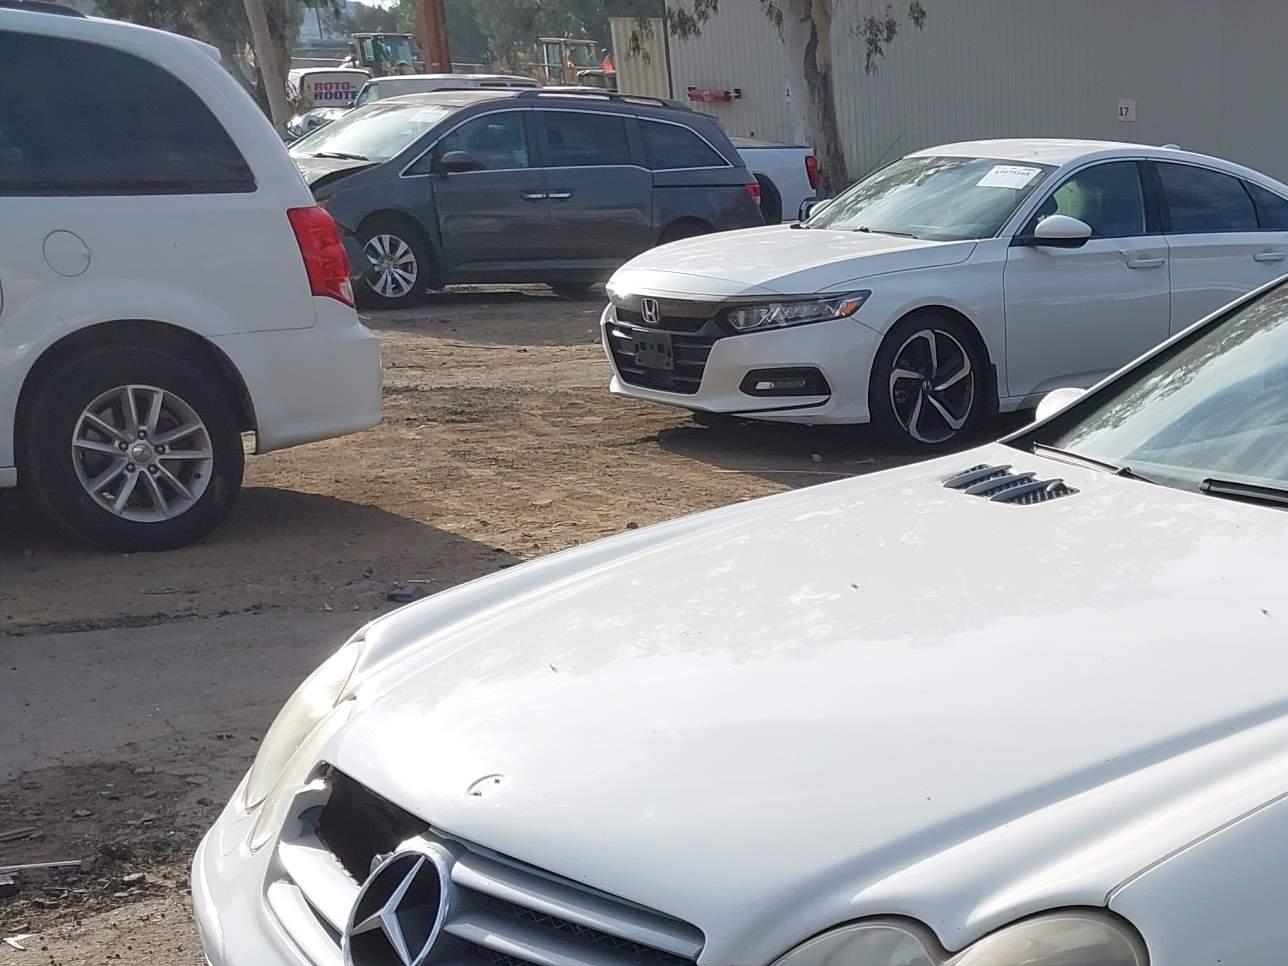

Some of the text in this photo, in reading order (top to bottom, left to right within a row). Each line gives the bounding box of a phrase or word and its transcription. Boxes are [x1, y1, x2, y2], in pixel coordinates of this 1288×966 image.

[314, 82, 358, 91] ROTO-
[314, 91, 359, 100] ROOTE
[1119, 106, 1129, 116] 17
